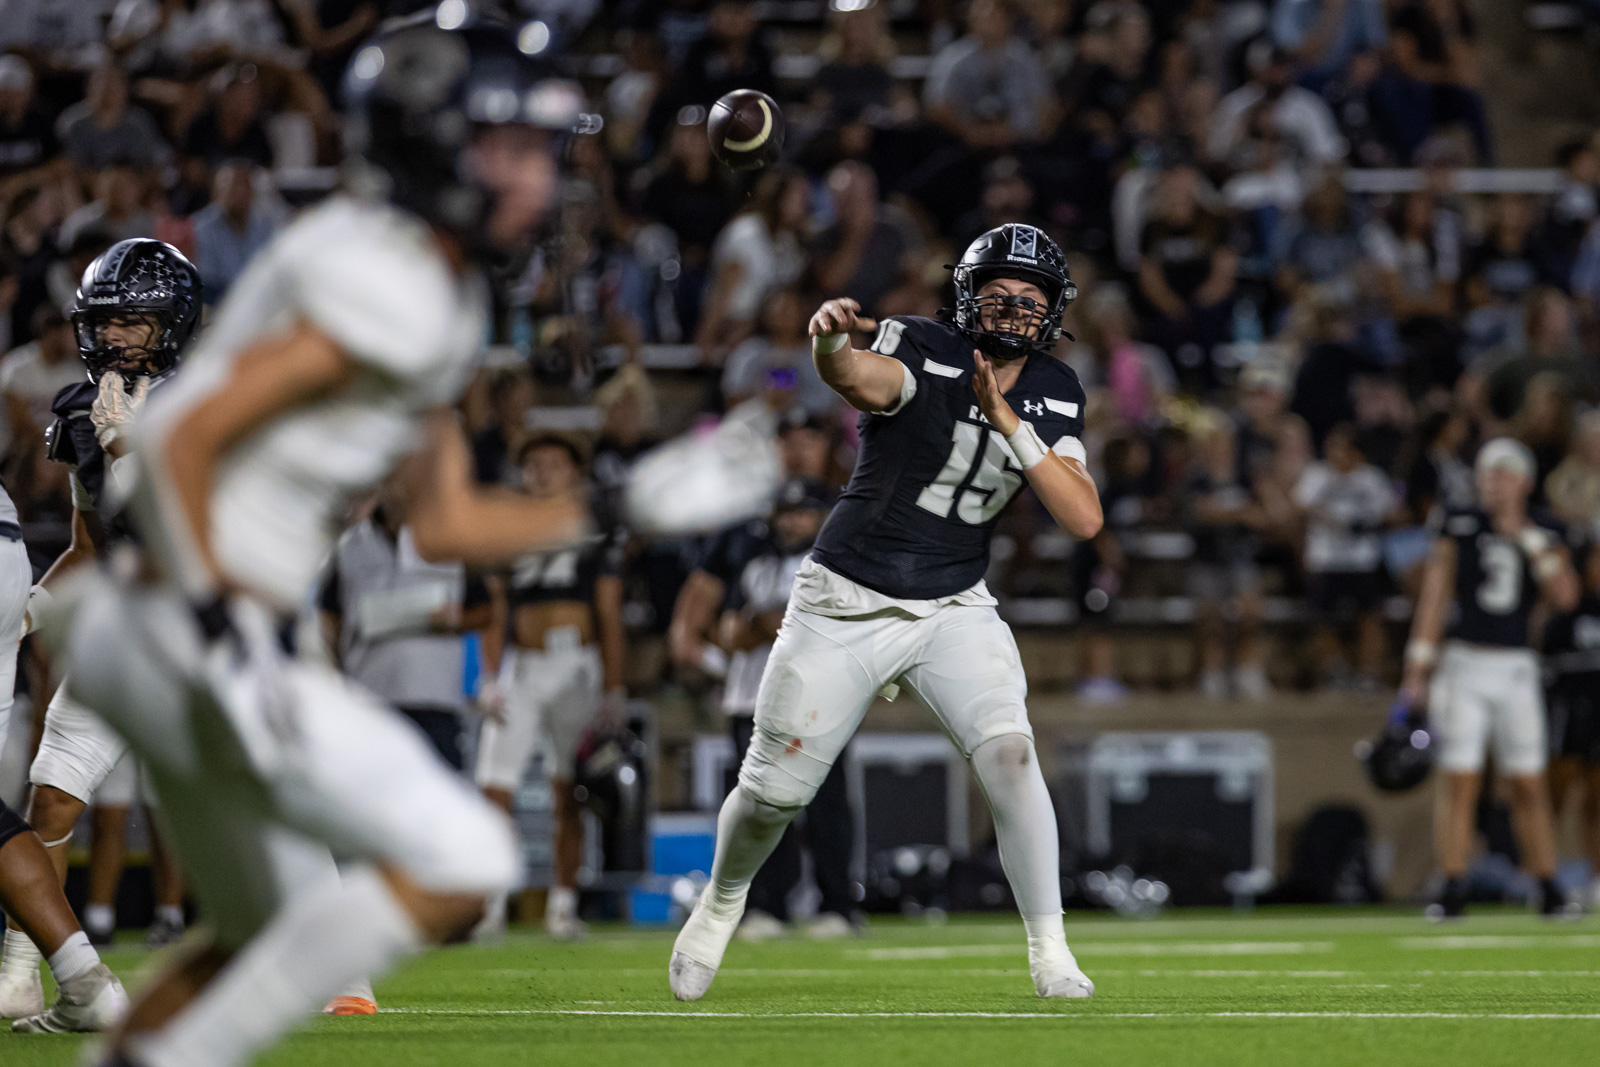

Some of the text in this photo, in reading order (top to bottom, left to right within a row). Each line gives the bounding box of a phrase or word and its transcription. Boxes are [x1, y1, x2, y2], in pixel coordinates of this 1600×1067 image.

[88, 295, 120, 305] Riddell
[915, 420, 1023, 525] 15
[1478, 538, 1520, 615] 3
